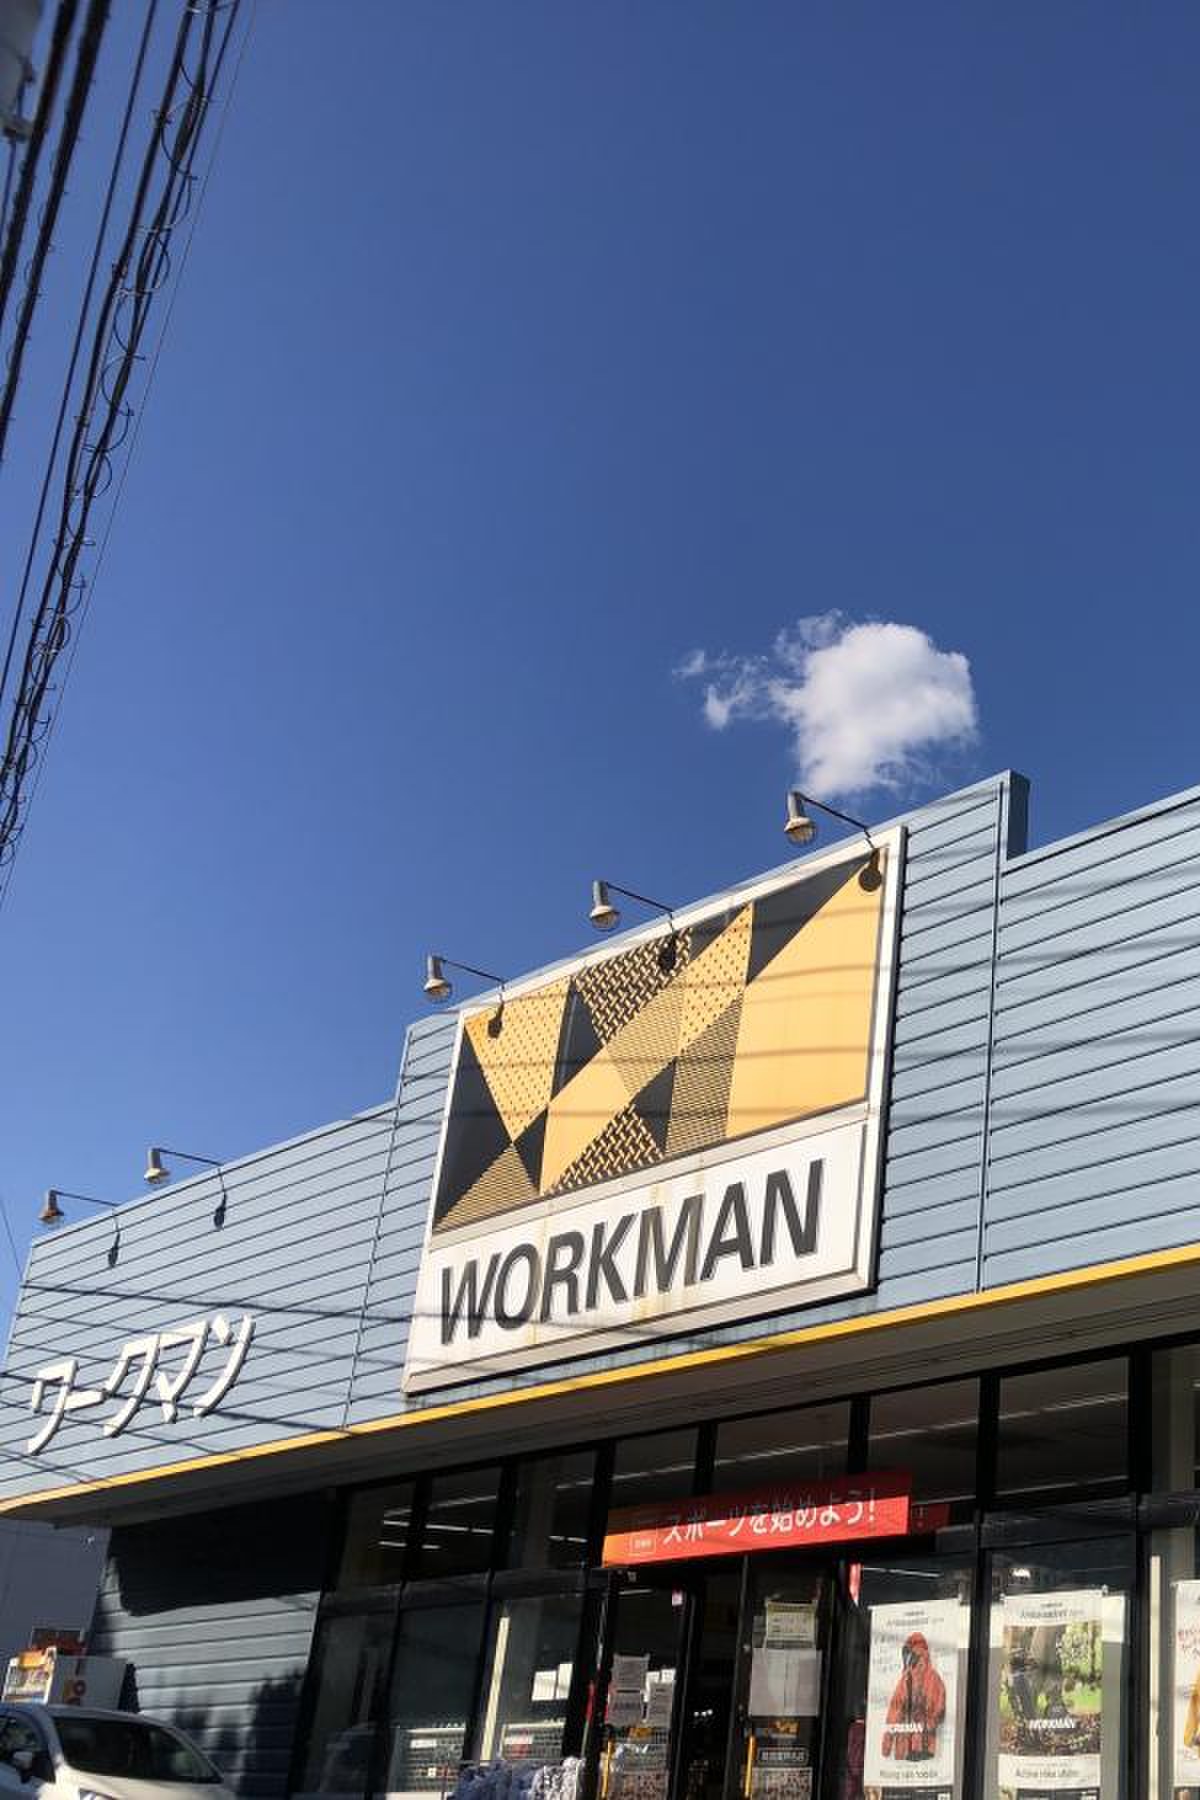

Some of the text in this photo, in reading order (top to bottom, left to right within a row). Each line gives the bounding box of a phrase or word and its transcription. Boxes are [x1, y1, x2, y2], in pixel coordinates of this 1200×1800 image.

[441, 1158, 823, 1345] WORKMAN
[27, 1312, 255, 1455] ワークマン
